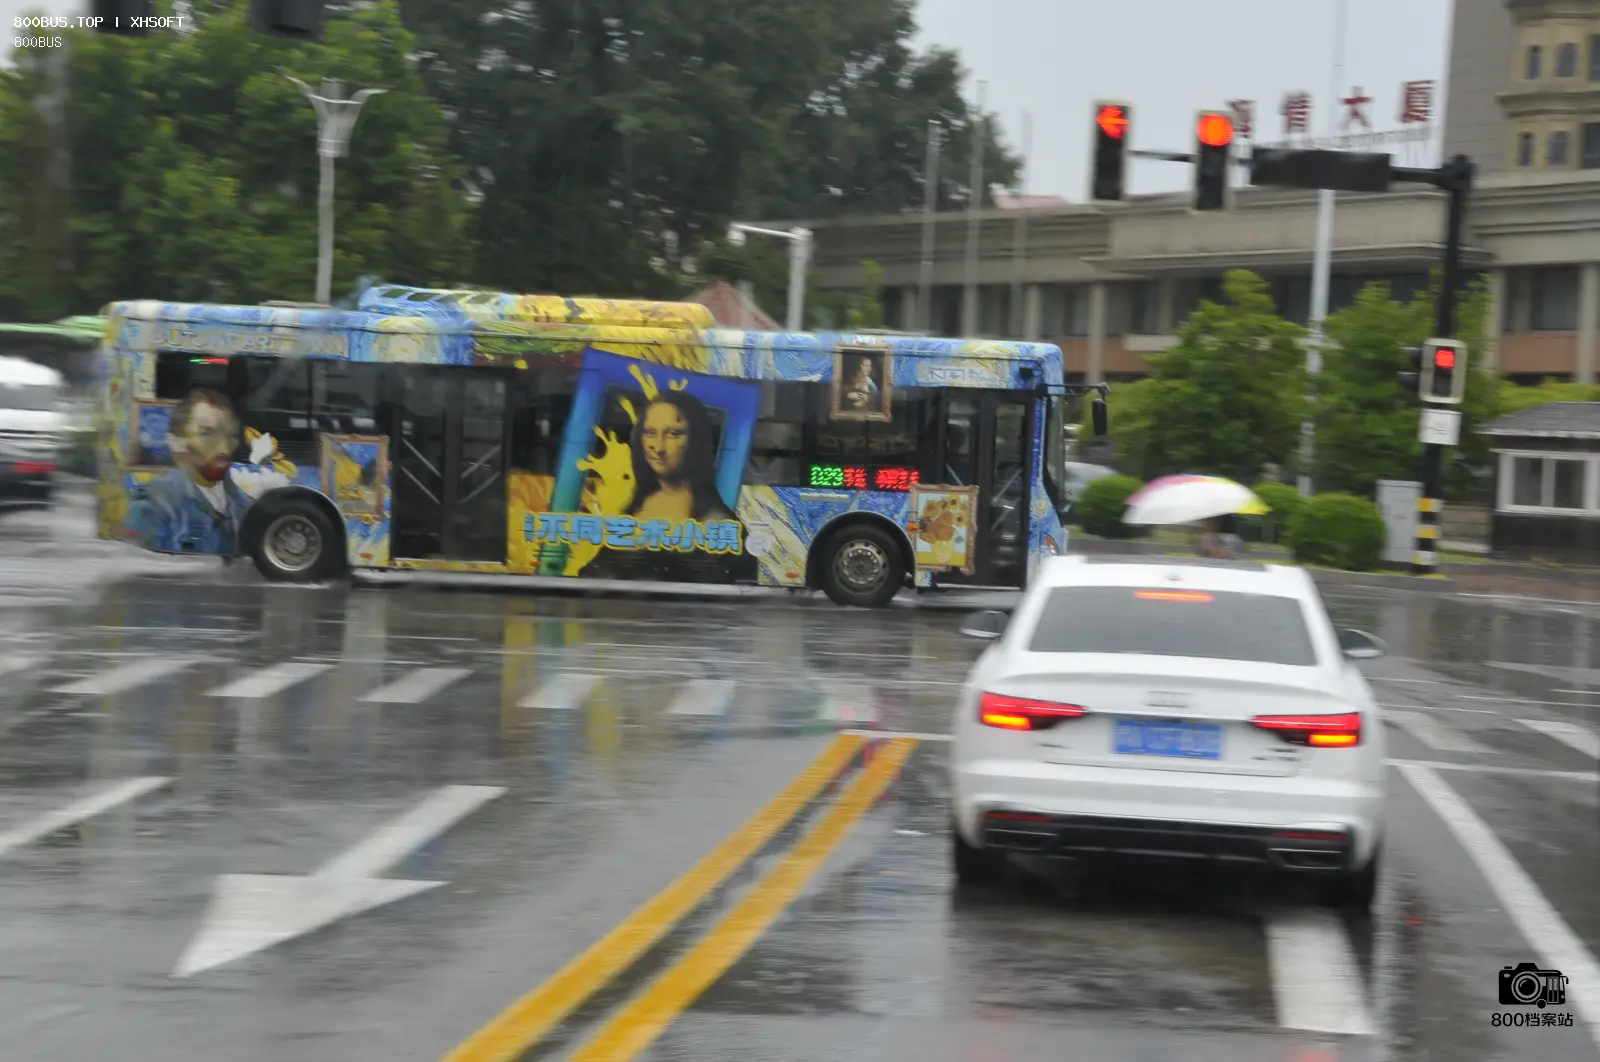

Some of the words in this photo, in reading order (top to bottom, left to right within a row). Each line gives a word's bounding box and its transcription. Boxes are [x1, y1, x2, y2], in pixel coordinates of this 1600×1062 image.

[536, 514, 741, 552] 不同艺术小镇
